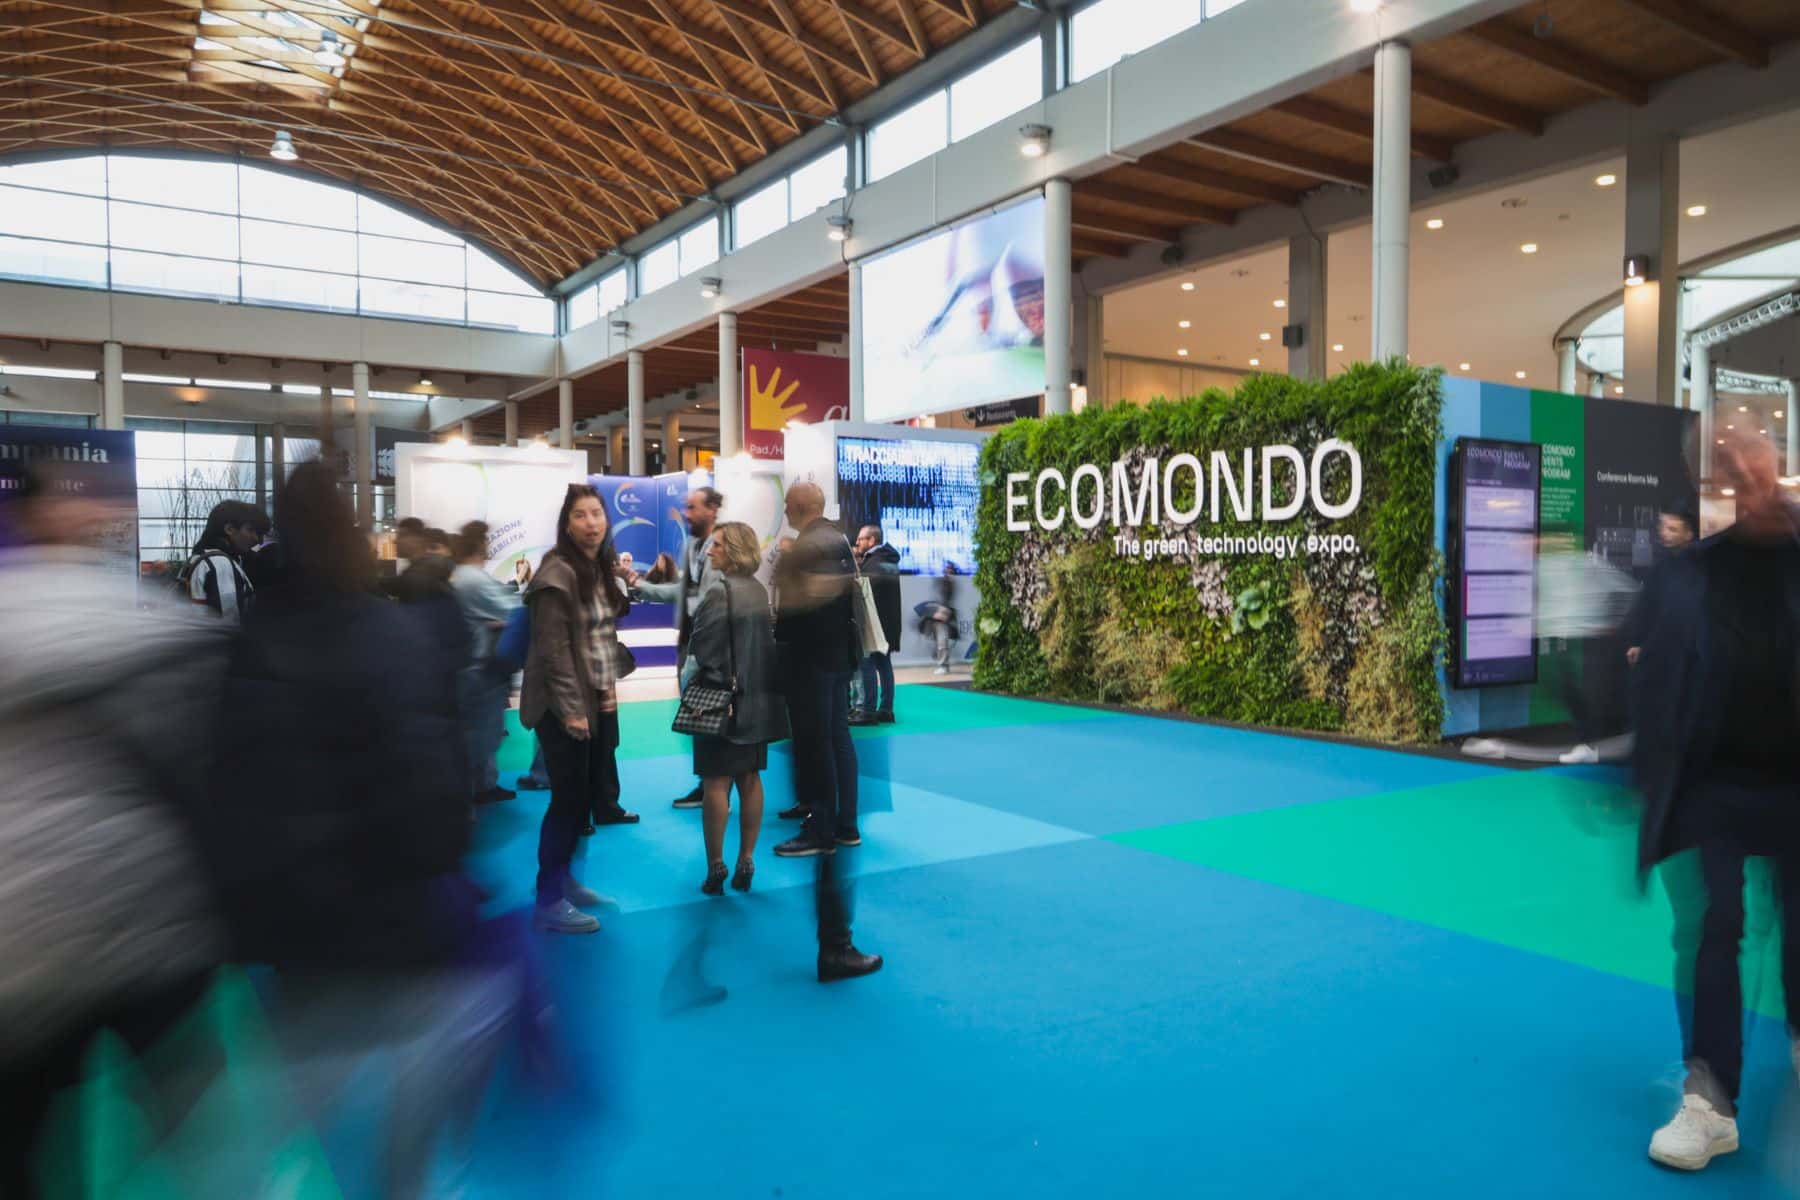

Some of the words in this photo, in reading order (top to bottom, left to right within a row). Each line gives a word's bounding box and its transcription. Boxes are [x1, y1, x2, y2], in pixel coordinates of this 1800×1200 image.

[1542, 444, 1575, 457] COMONDO
[1542, 456, 1563, 467] VENTS
[1542, 467, 1571, 480] ROGRAM
[1006, 437, 1363, 532] ECOMONDO
[1113, 535, 1140, 556] The
[1143, 537, 1189, 560] green
[1196, 531, 1298, 559] technology
[1305, 533, 1361, 557] expo.
